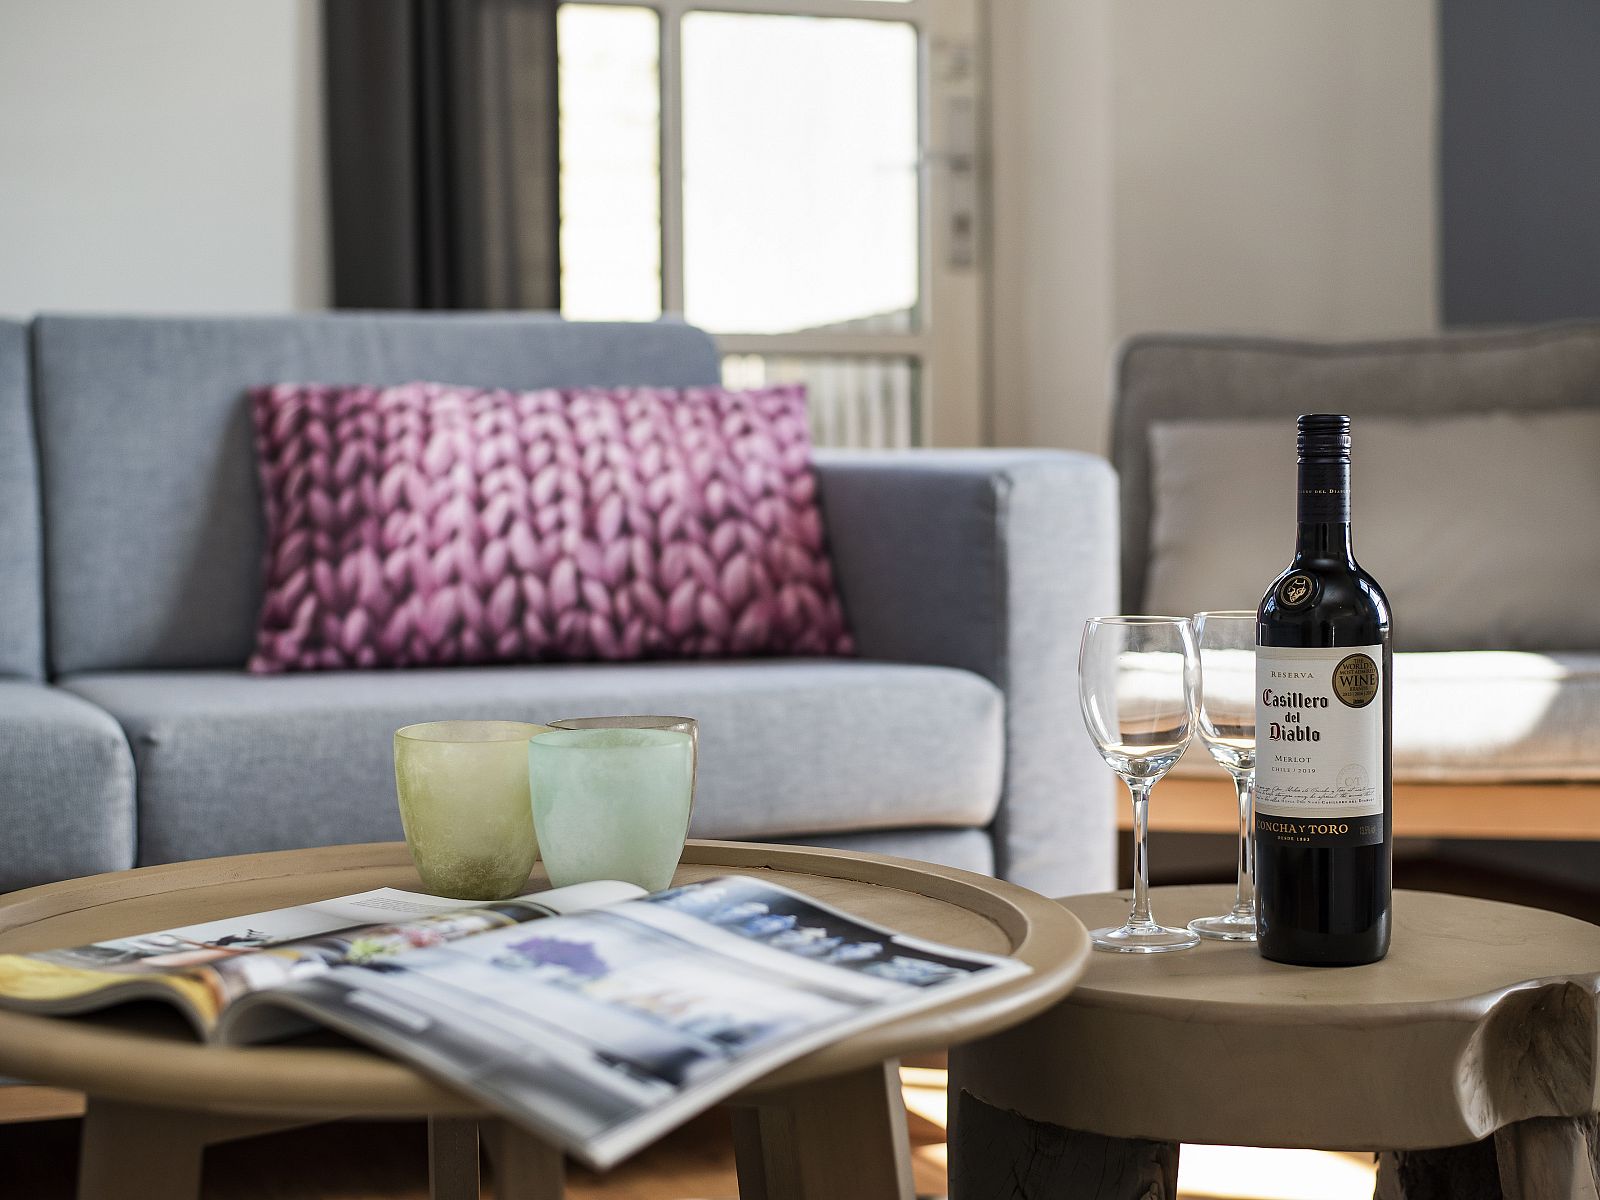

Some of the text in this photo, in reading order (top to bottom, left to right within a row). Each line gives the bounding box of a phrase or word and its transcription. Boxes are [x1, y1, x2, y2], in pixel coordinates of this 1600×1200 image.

[1339, 674, 1376, 687] WINE
[1262, 688, 1329, 708] Casillero
[1284, 711, 1301, 723] del
[1269, 722, 1321, 742] Diablo
[1299, 825, 1306, 833] Y
[1307, 823, 1349, 835] TORO
